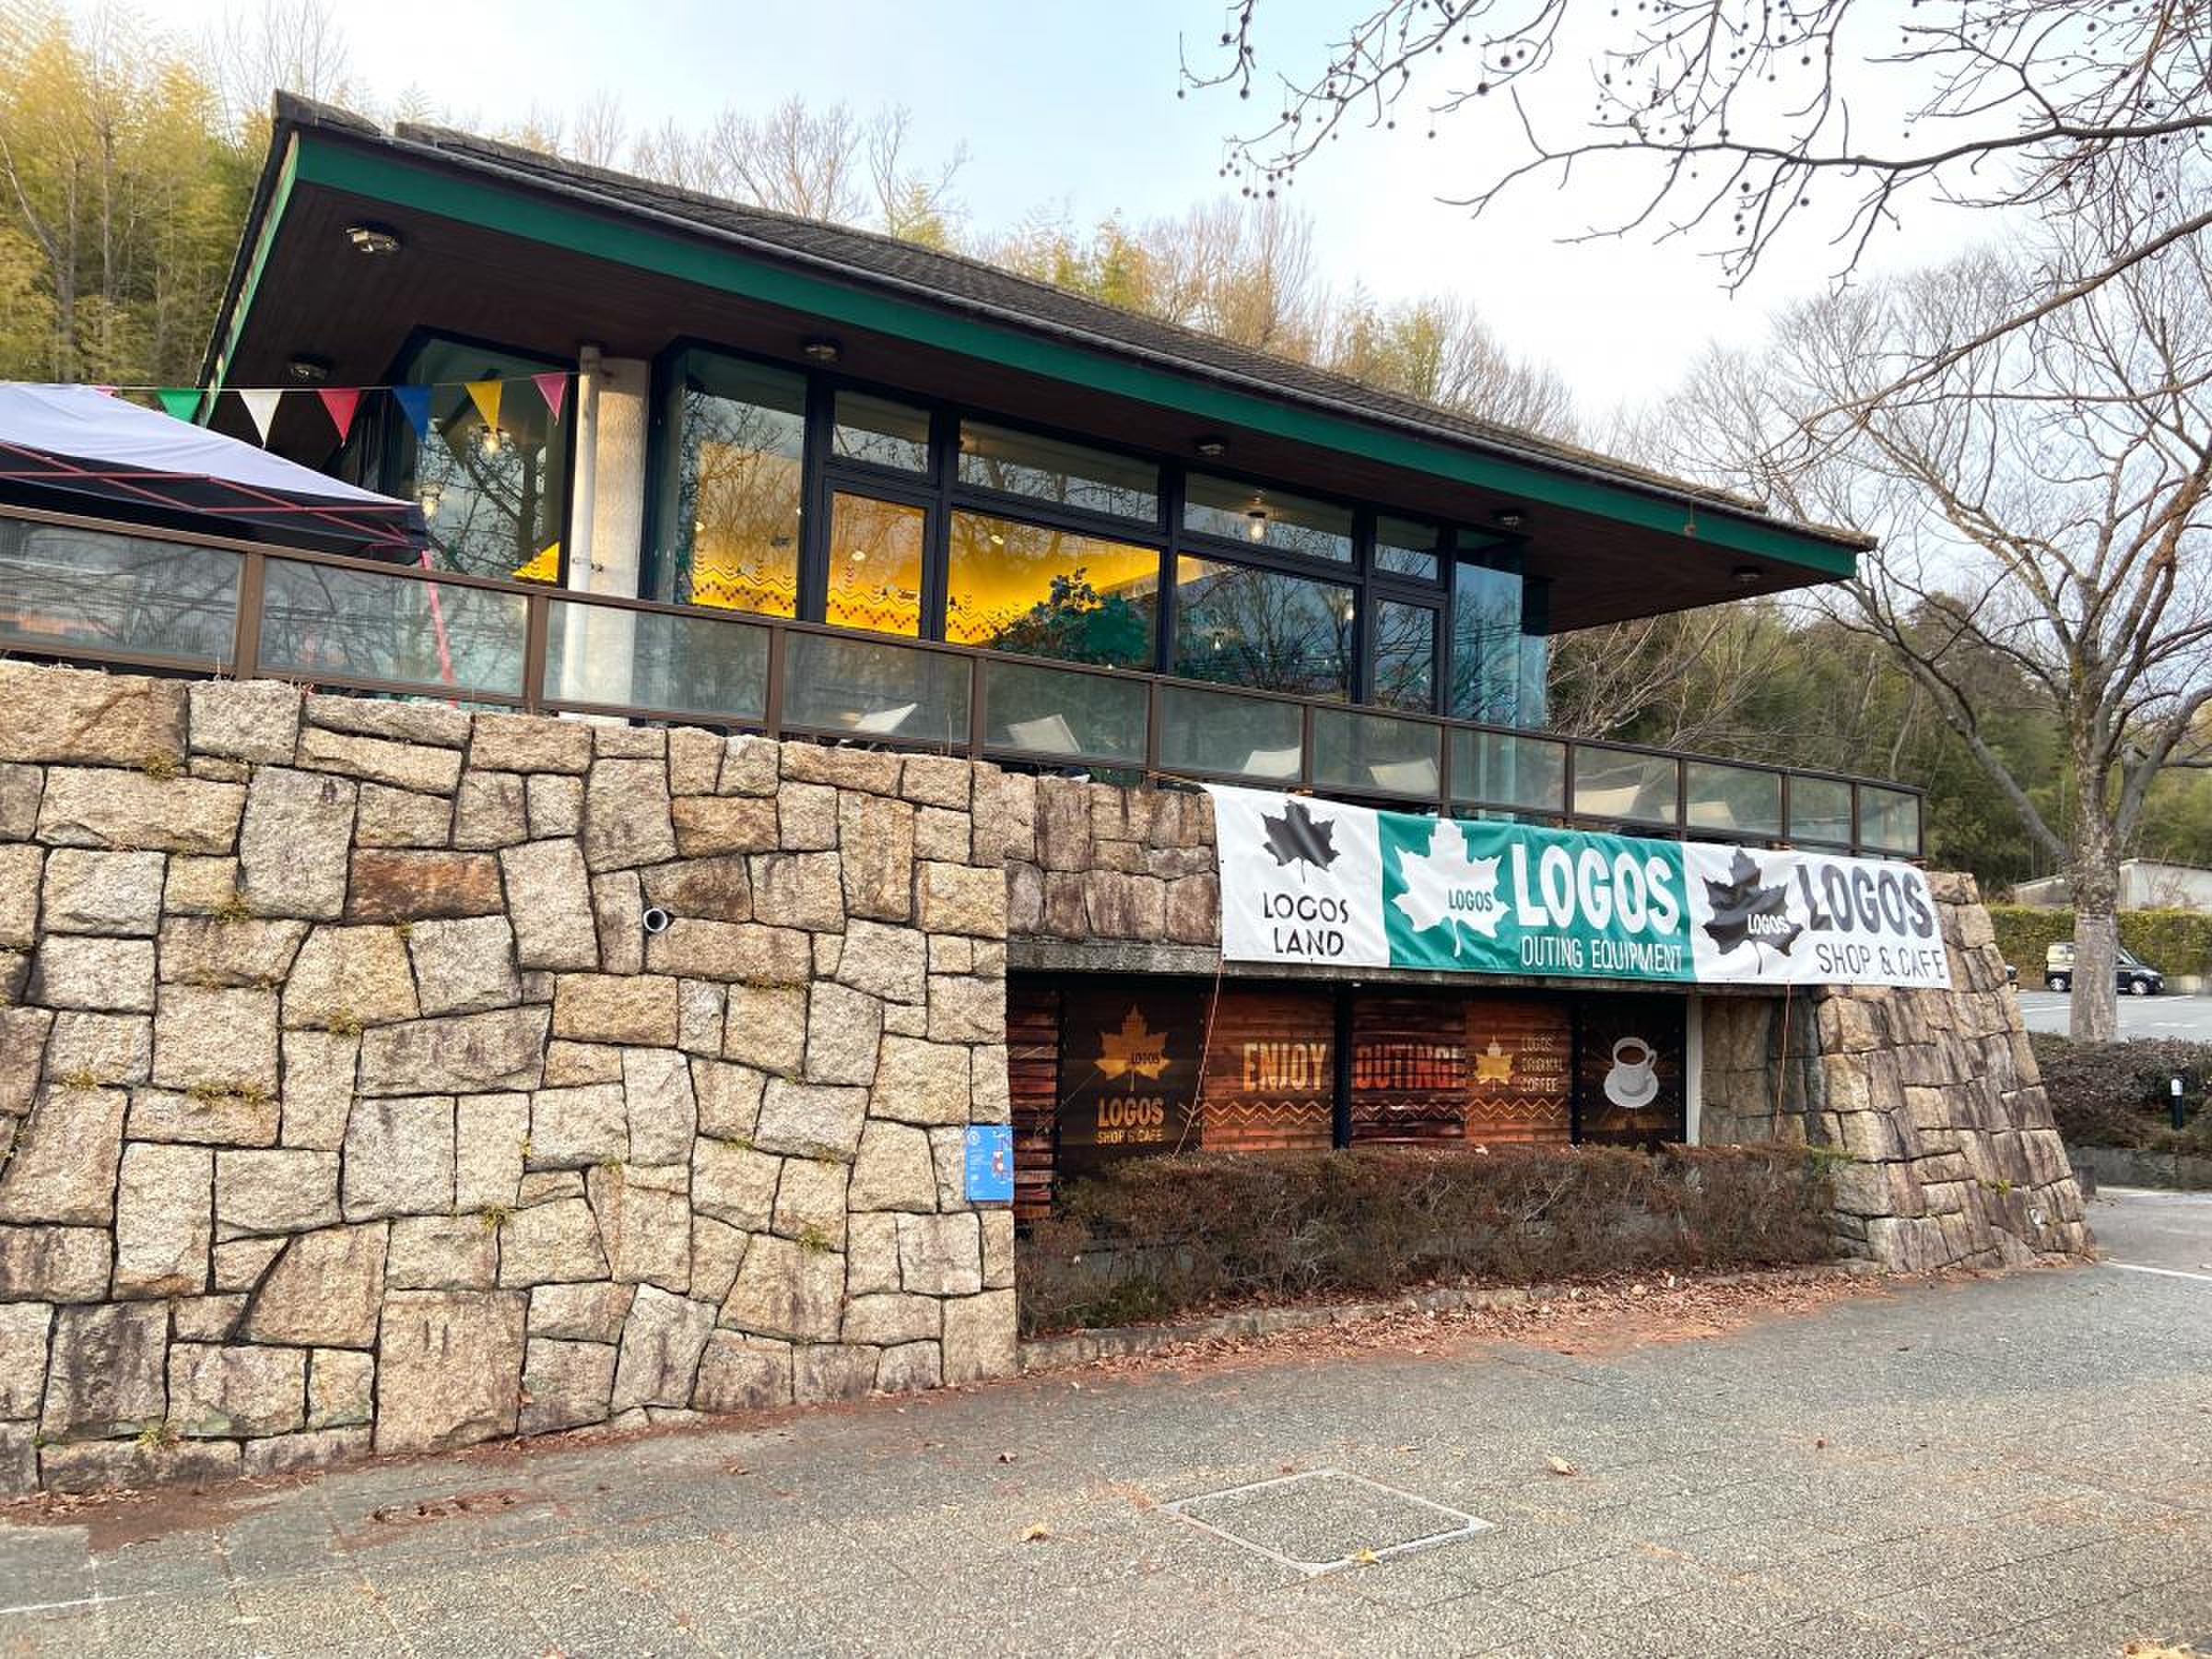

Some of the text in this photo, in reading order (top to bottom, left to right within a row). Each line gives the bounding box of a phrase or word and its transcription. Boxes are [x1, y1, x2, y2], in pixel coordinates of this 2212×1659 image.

[1447, 888, 1494, 913] LOGOS
[1511, 842, 1680, 935] LOGOS
[1796, 864, 1934, 939] LOGOS
[1263, 890, 1350, 924] LOGOS
[1747, 913, 1791, 935] LOGOS
[1274, 927, 1346, 958] LAND
[1521, 935, 1683, 974] OUTING EQUIPMENT
[1816, 943, 1947, 981] SHOP & CAFE
[1243, 1042, 1327, 1092] ENJOY
[1521, 1077, 1559, 1092] COFFEE
[1098, 1097, 1165, 1127] LOGOS
[1095, 1130, 1124, 1145] SHOP
[1137, 1129, 1164, 1143] CAFE
